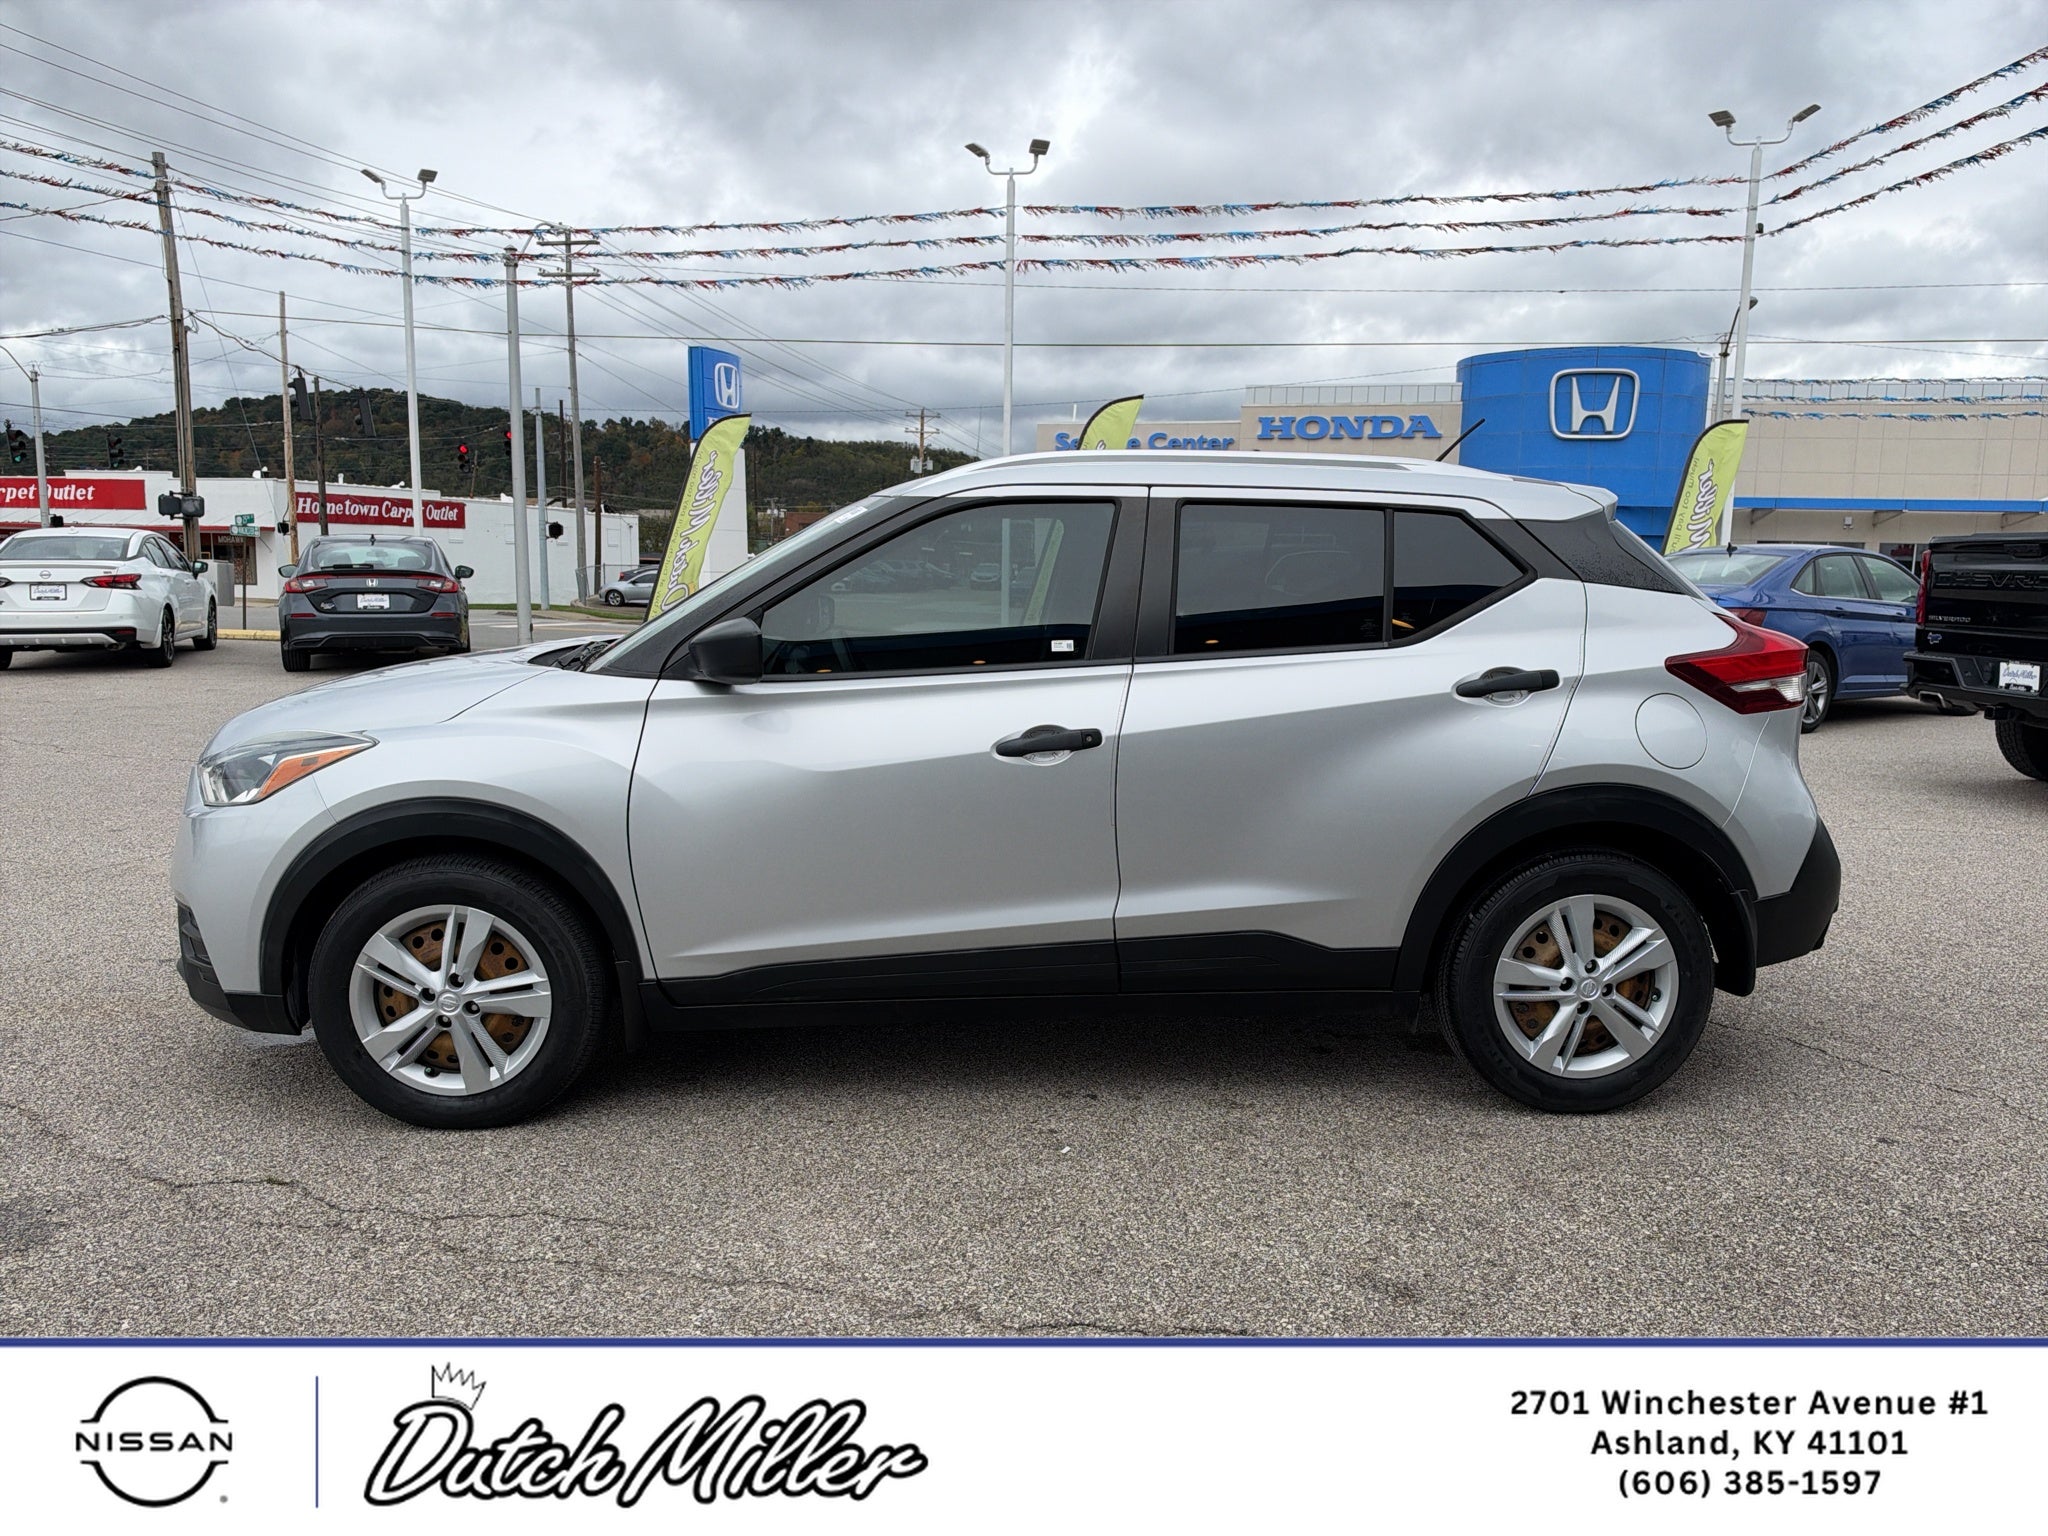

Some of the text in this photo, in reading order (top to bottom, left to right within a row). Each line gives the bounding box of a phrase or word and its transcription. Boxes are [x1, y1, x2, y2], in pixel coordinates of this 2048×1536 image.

[1256, 415, 1442, 441] HONDA
[1148, 432, 1235, 450] Center
[297, 497, 459, 522] Hometown Carp Outlet
